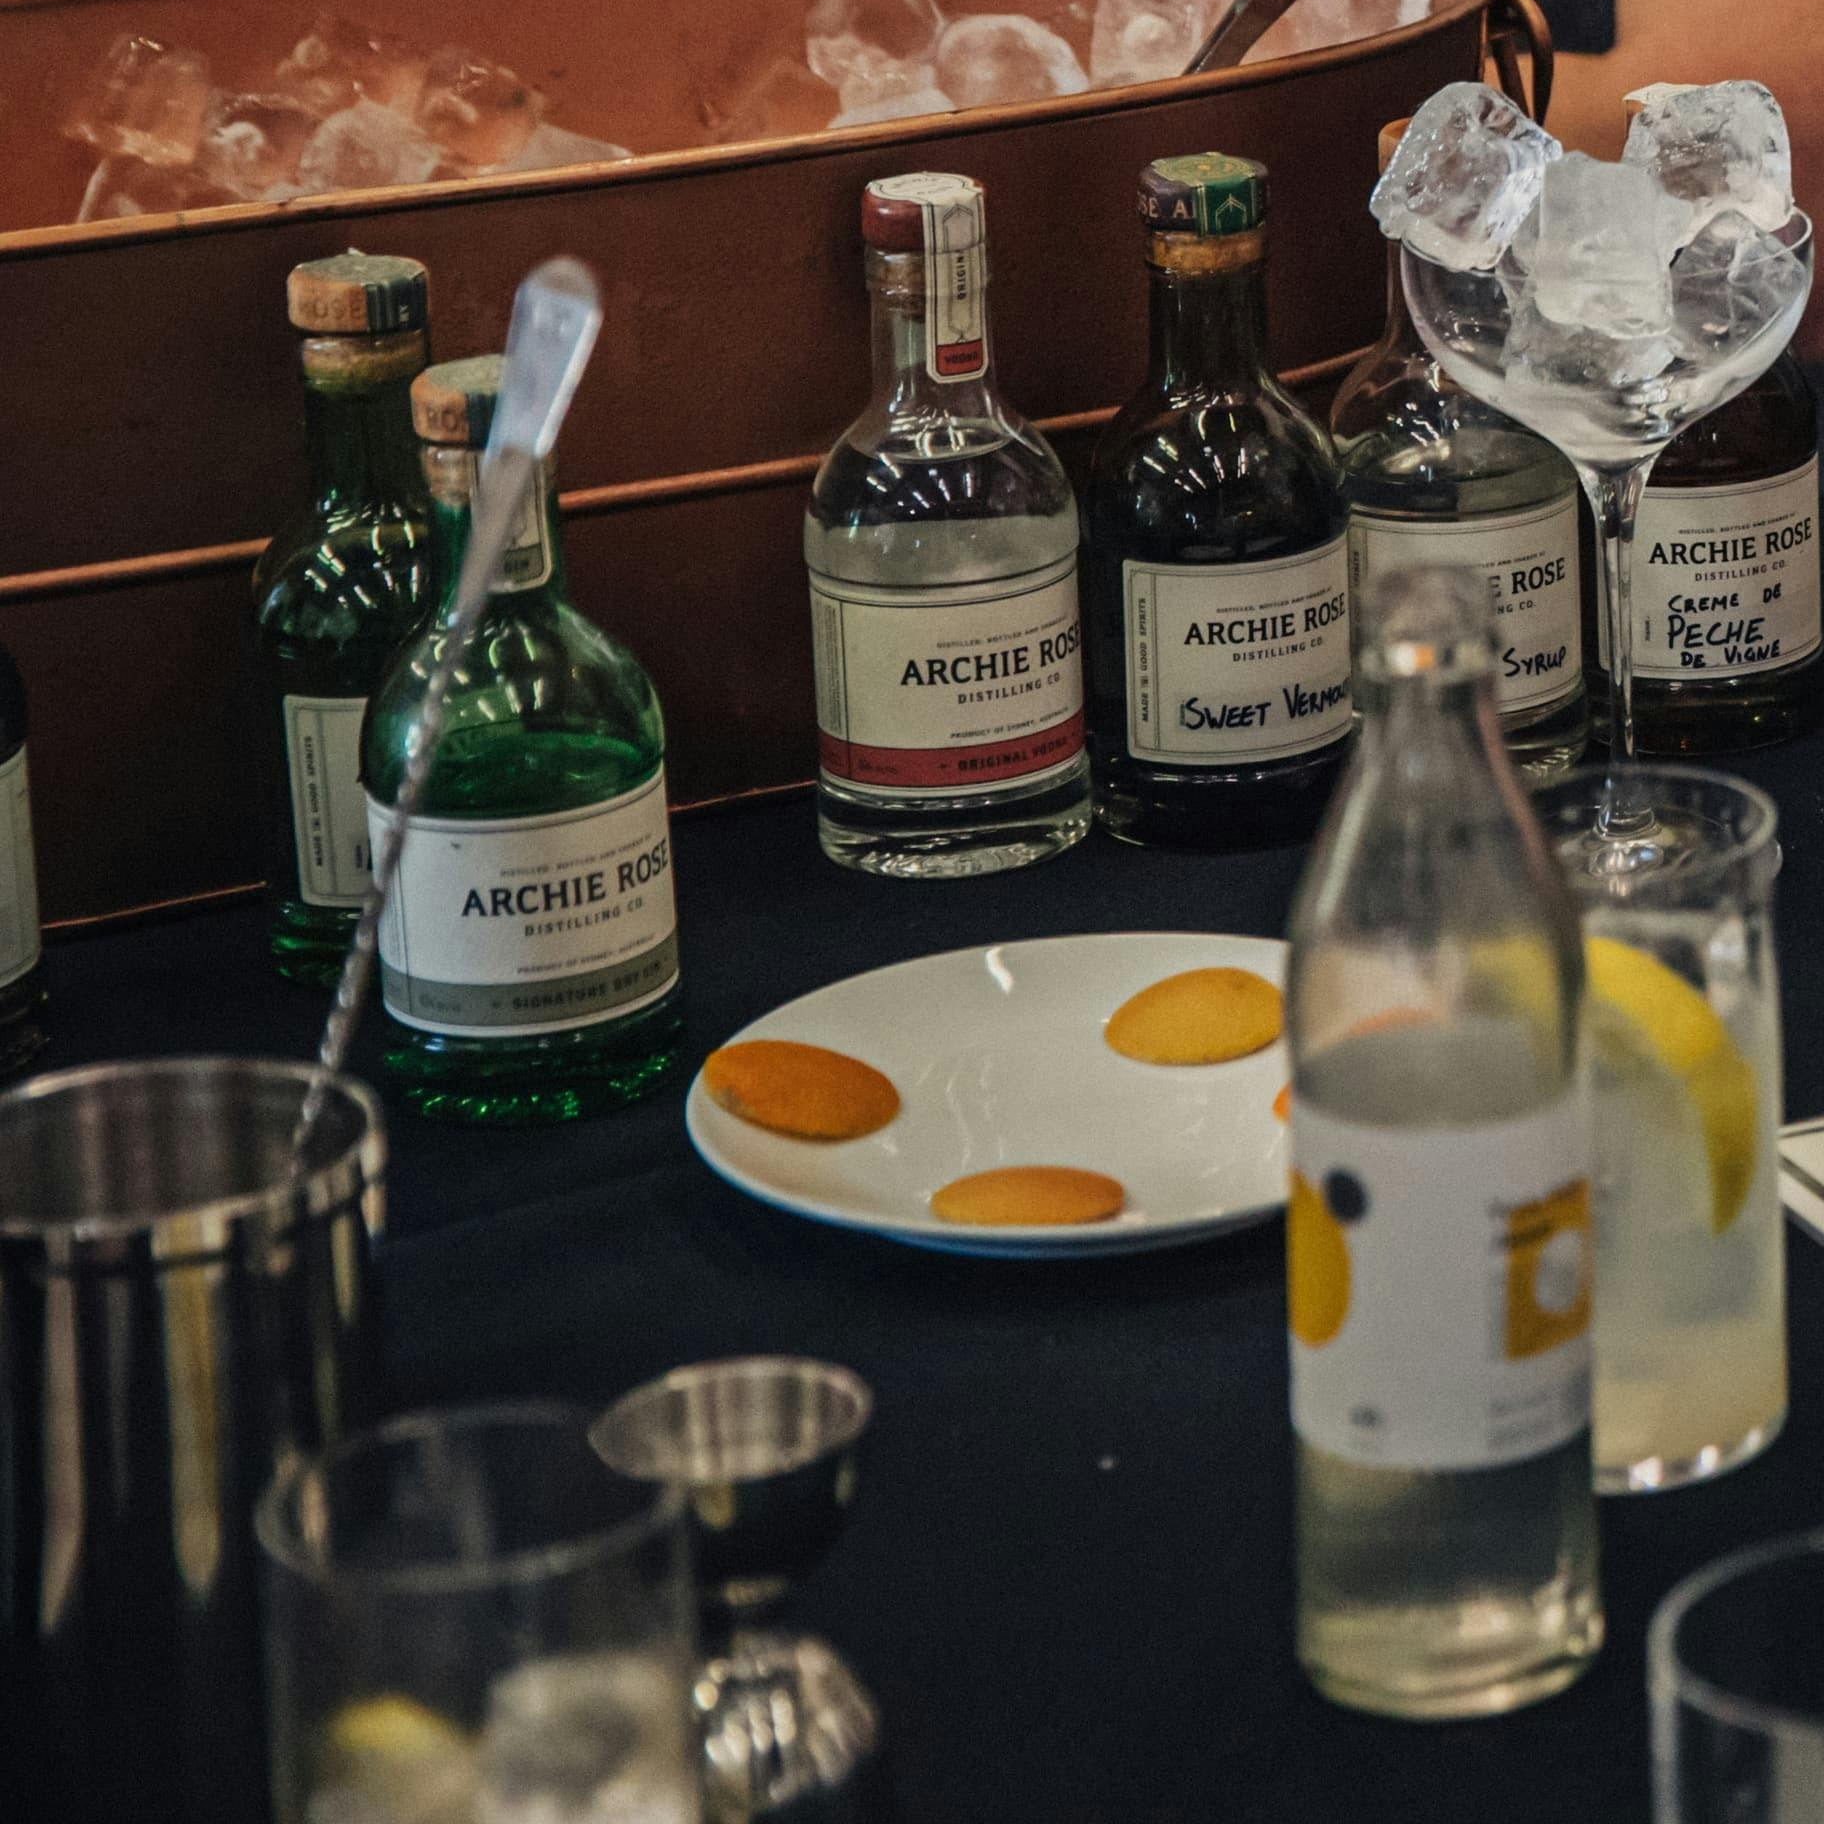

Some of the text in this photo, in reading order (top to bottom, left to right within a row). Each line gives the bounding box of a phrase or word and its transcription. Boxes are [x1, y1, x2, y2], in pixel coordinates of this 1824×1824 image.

[1649, 516, 1812, 565] ARCHIE ROSE
[1511, 557, 1566, 595] ROSE
[1695, 564, 1768, 582] DISTILLING
[1668, 583, 1782, 614] CREME DE
[1183, 613, 1296, 646] ARCHIE
[1304, 592, 1346, 633] ROSE
[1667, 614, 1766, 650] PECHE
[900, 646, 1030, 686] ARCHIE
[1232, 642, 1306, 662] DISTILLING
[1502, 646, 1567, 677] SYRUP
[1680, 652, 1706, 669] DE
[957, 679, 1042, 705] DISTILLING
[1185, 696, 1272, 730] SWEET
[461, 838, 669, 918] ARCHIE ROSE
[525, 907, 621, 937] DISTILLING
